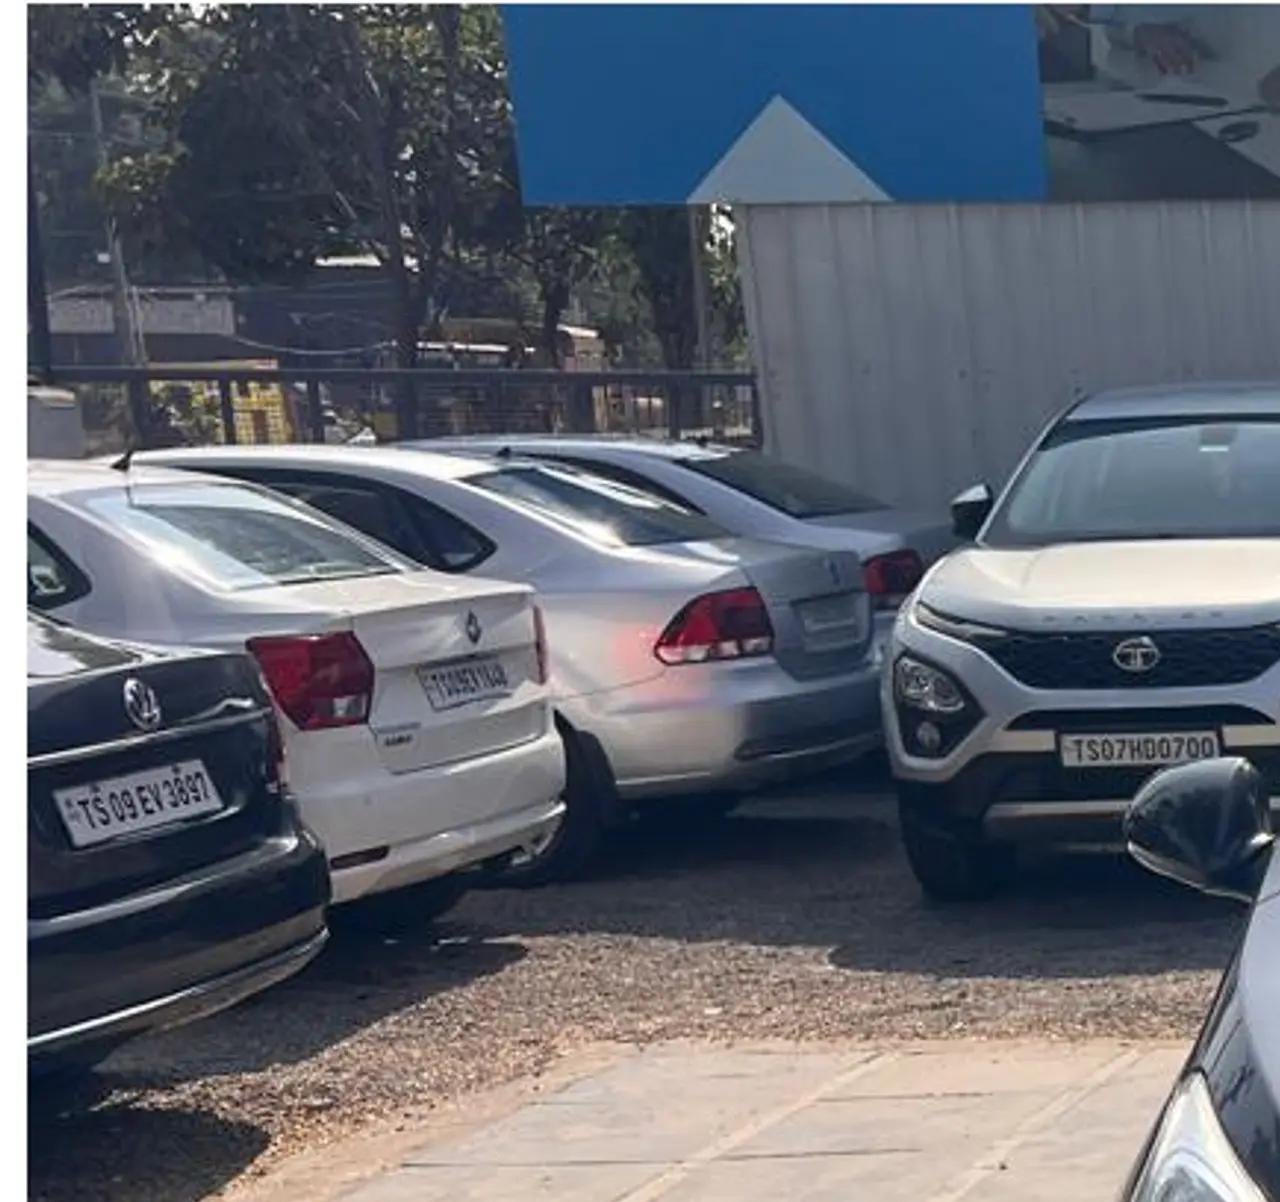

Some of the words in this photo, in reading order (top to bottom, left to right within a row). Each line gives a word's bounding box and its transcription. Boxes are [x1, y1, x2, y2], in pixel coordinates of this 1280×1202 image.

[1072, 737, 1216, 763] TS07HD0700
[77, 797, 110, 829] TS
[108, 789, 137, 823] 09
[135, 784, 164, 815] EV
